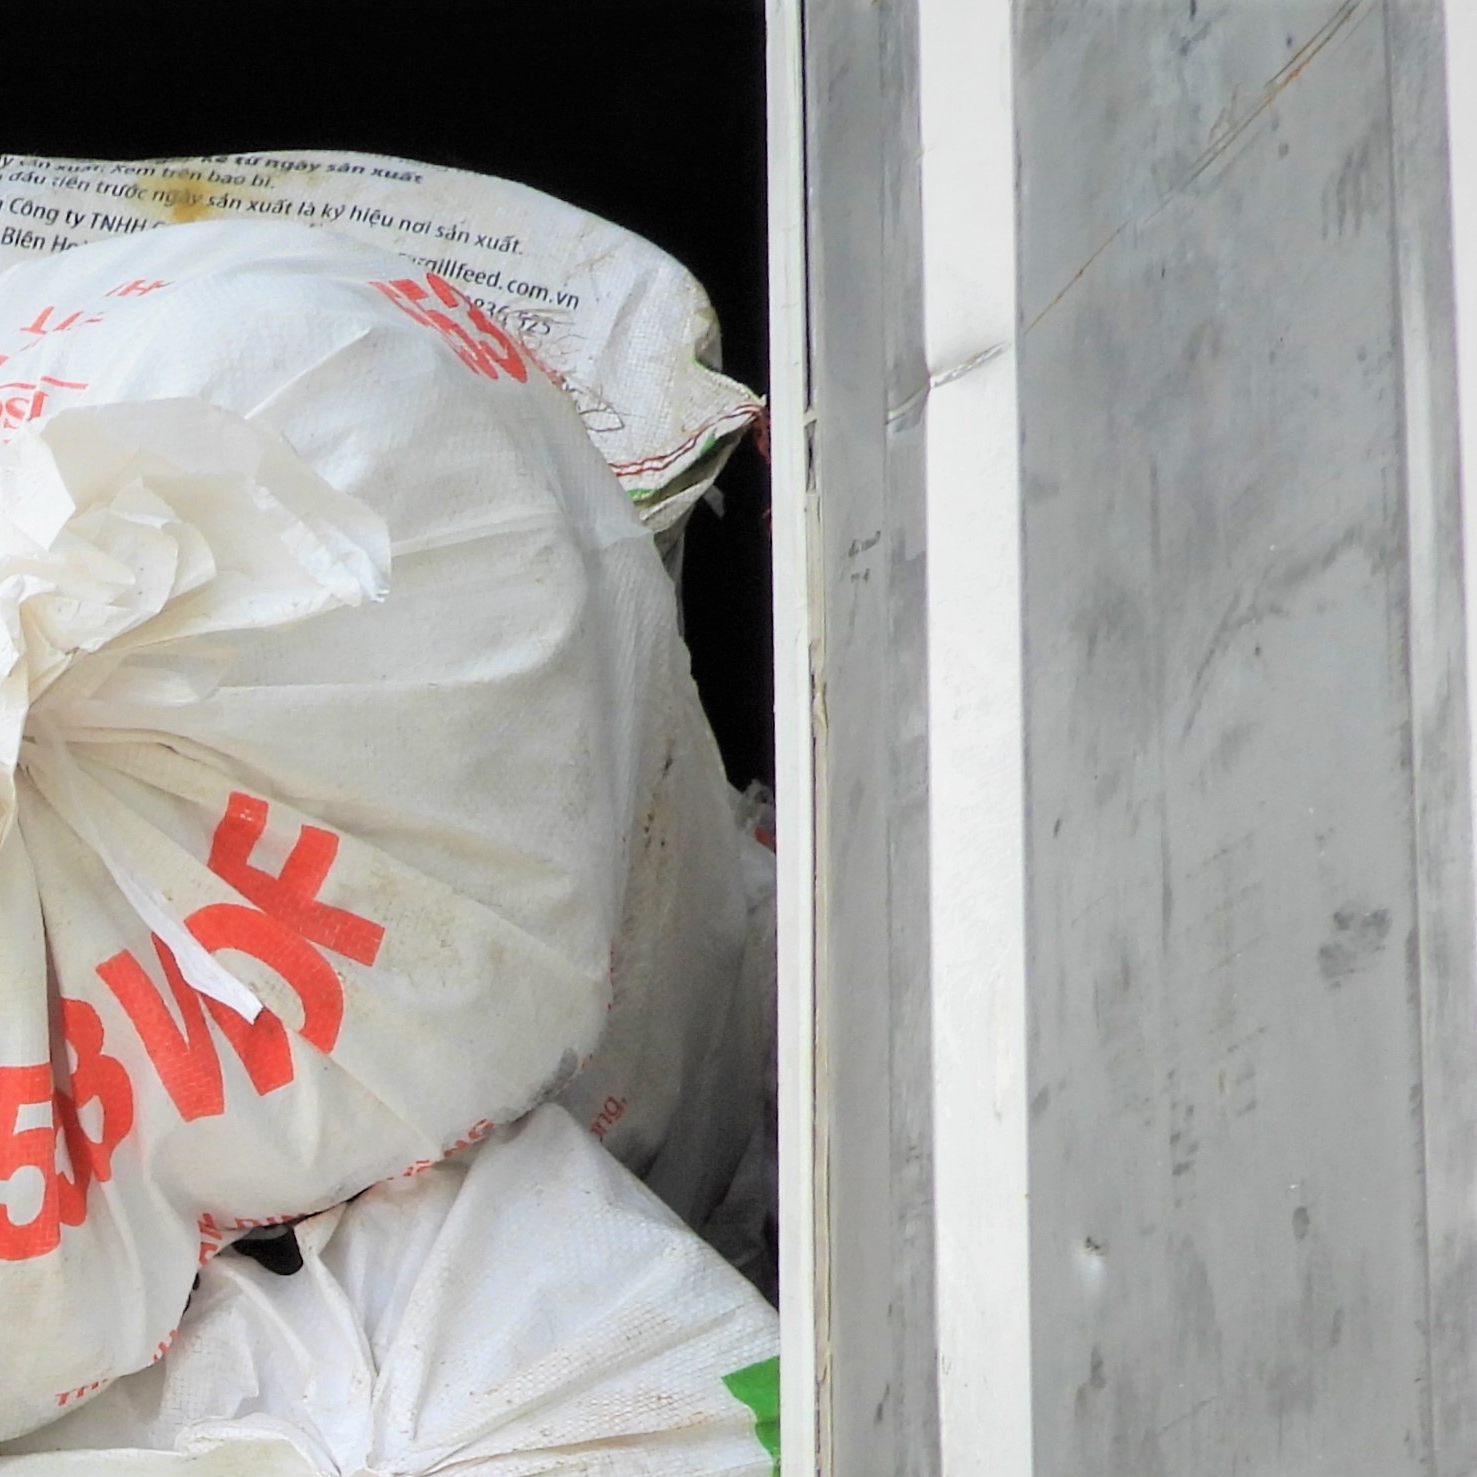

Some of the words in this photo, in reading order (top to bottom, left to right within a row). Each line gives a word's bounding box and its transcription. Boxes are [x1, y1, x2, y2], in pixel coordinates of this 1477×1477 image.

[207, 172, 245, 186] bao
[9, 197, 59, 226] Công
[65, 208, 85, 228] ty
[90, 211, 147, 235] TNHH
[246, 199, 292, 216] xuất
[297, 201, 315, 217] là
[349, 205, 394, 229] hiệu
[399, 218, 431, 235] nơi
[1, 225, 46, 251] Biên
[398, 252, 580, 311] gillfeed.com.vn
